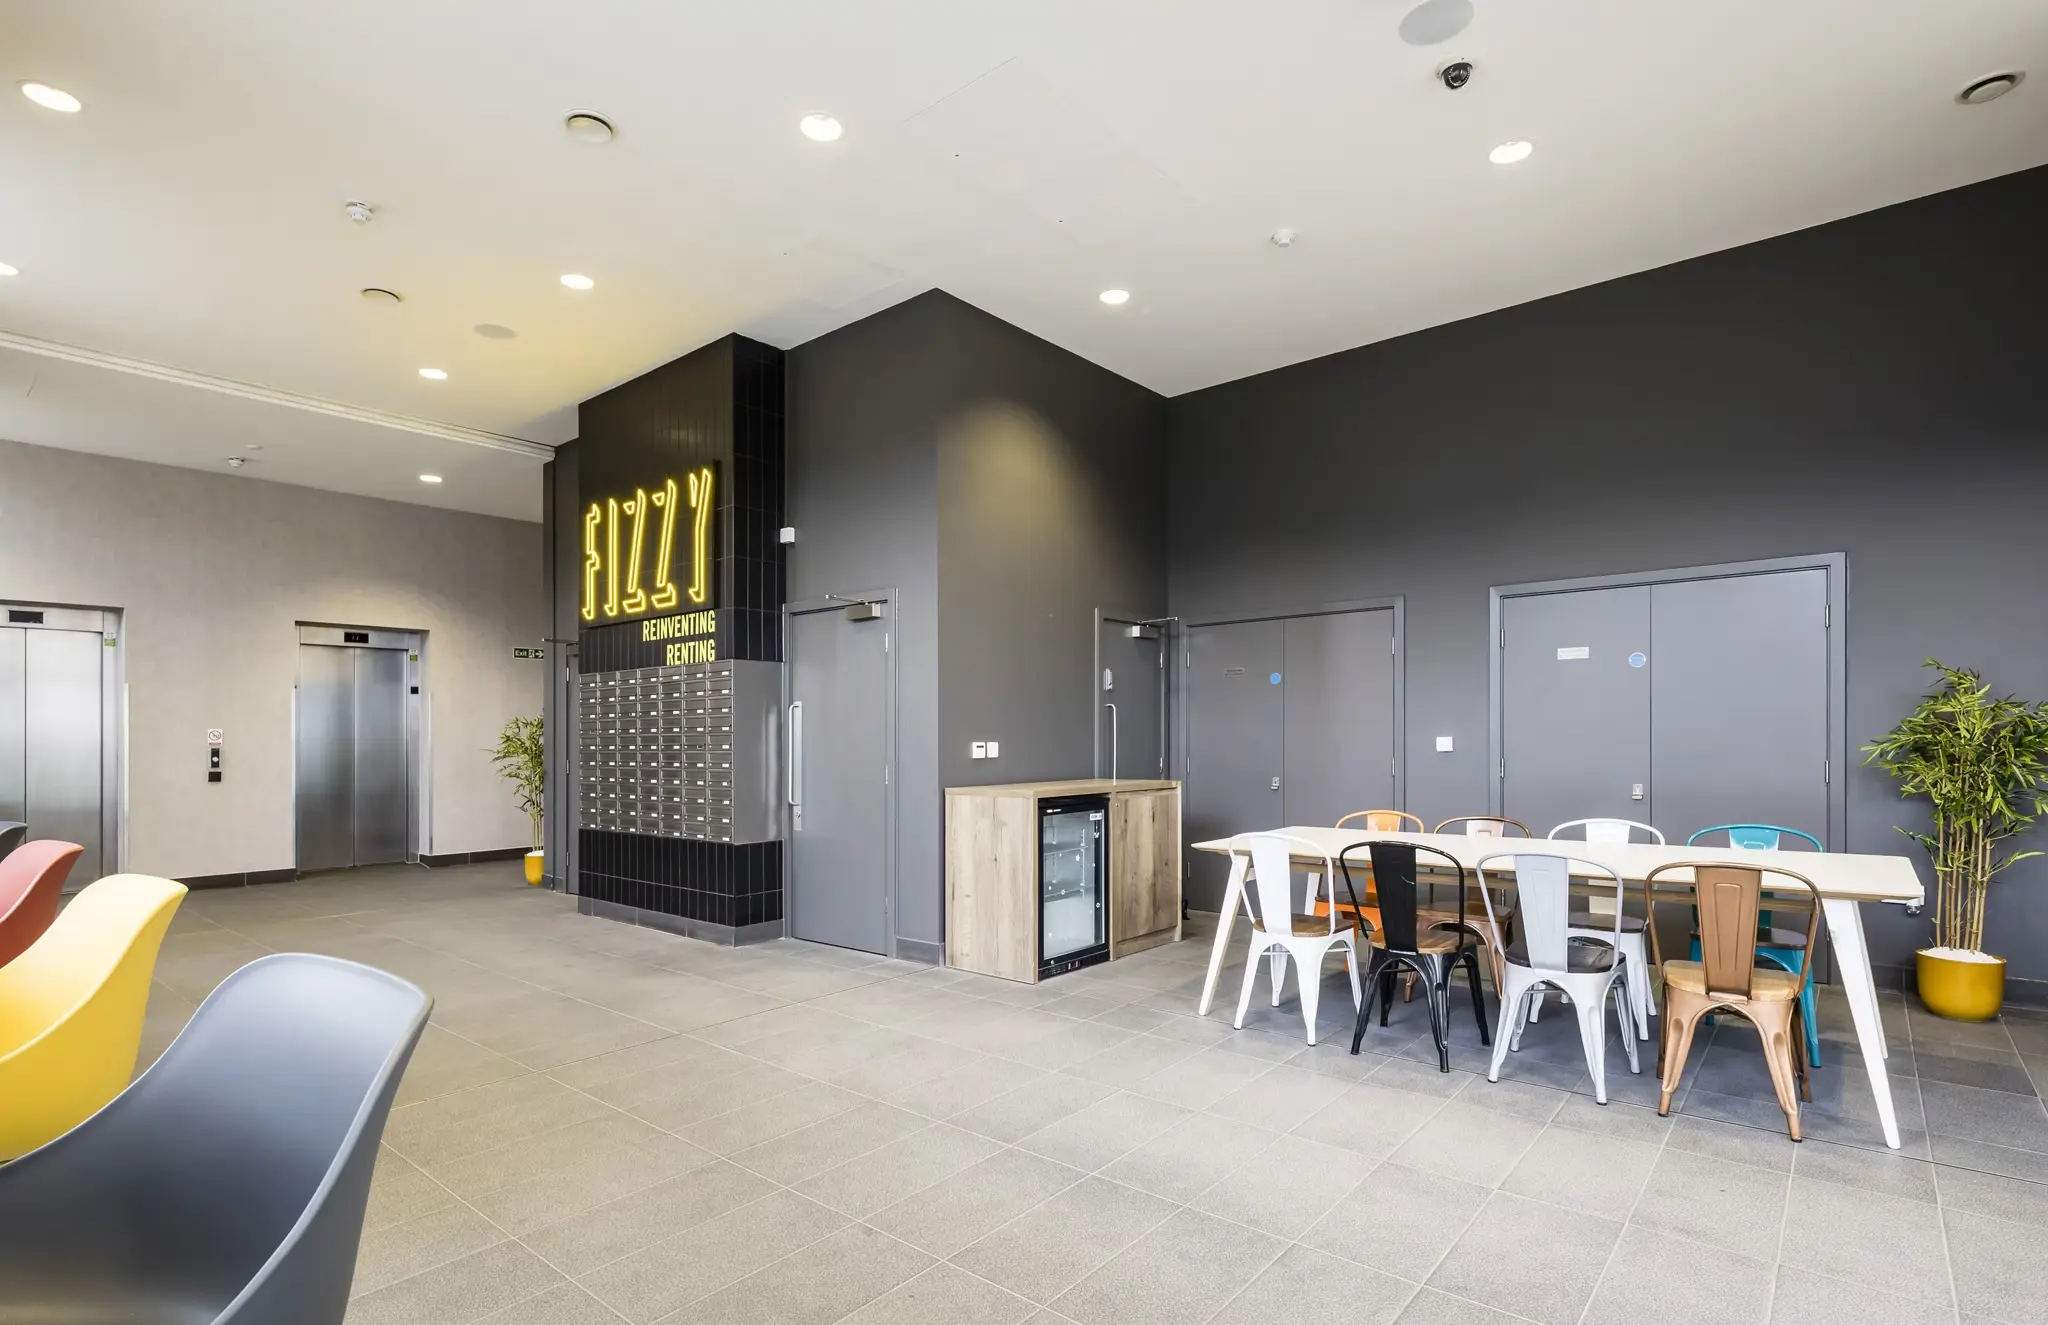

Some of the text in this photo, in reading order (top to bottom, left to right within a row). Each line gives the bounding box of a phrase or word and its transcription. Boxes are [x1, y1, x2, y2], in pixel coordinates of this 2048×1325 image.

[582, 468, 711, 620] FIZZY
[642, 610, 716, 642] REINVENTING
[666, 639, 716, 667] RENTING
